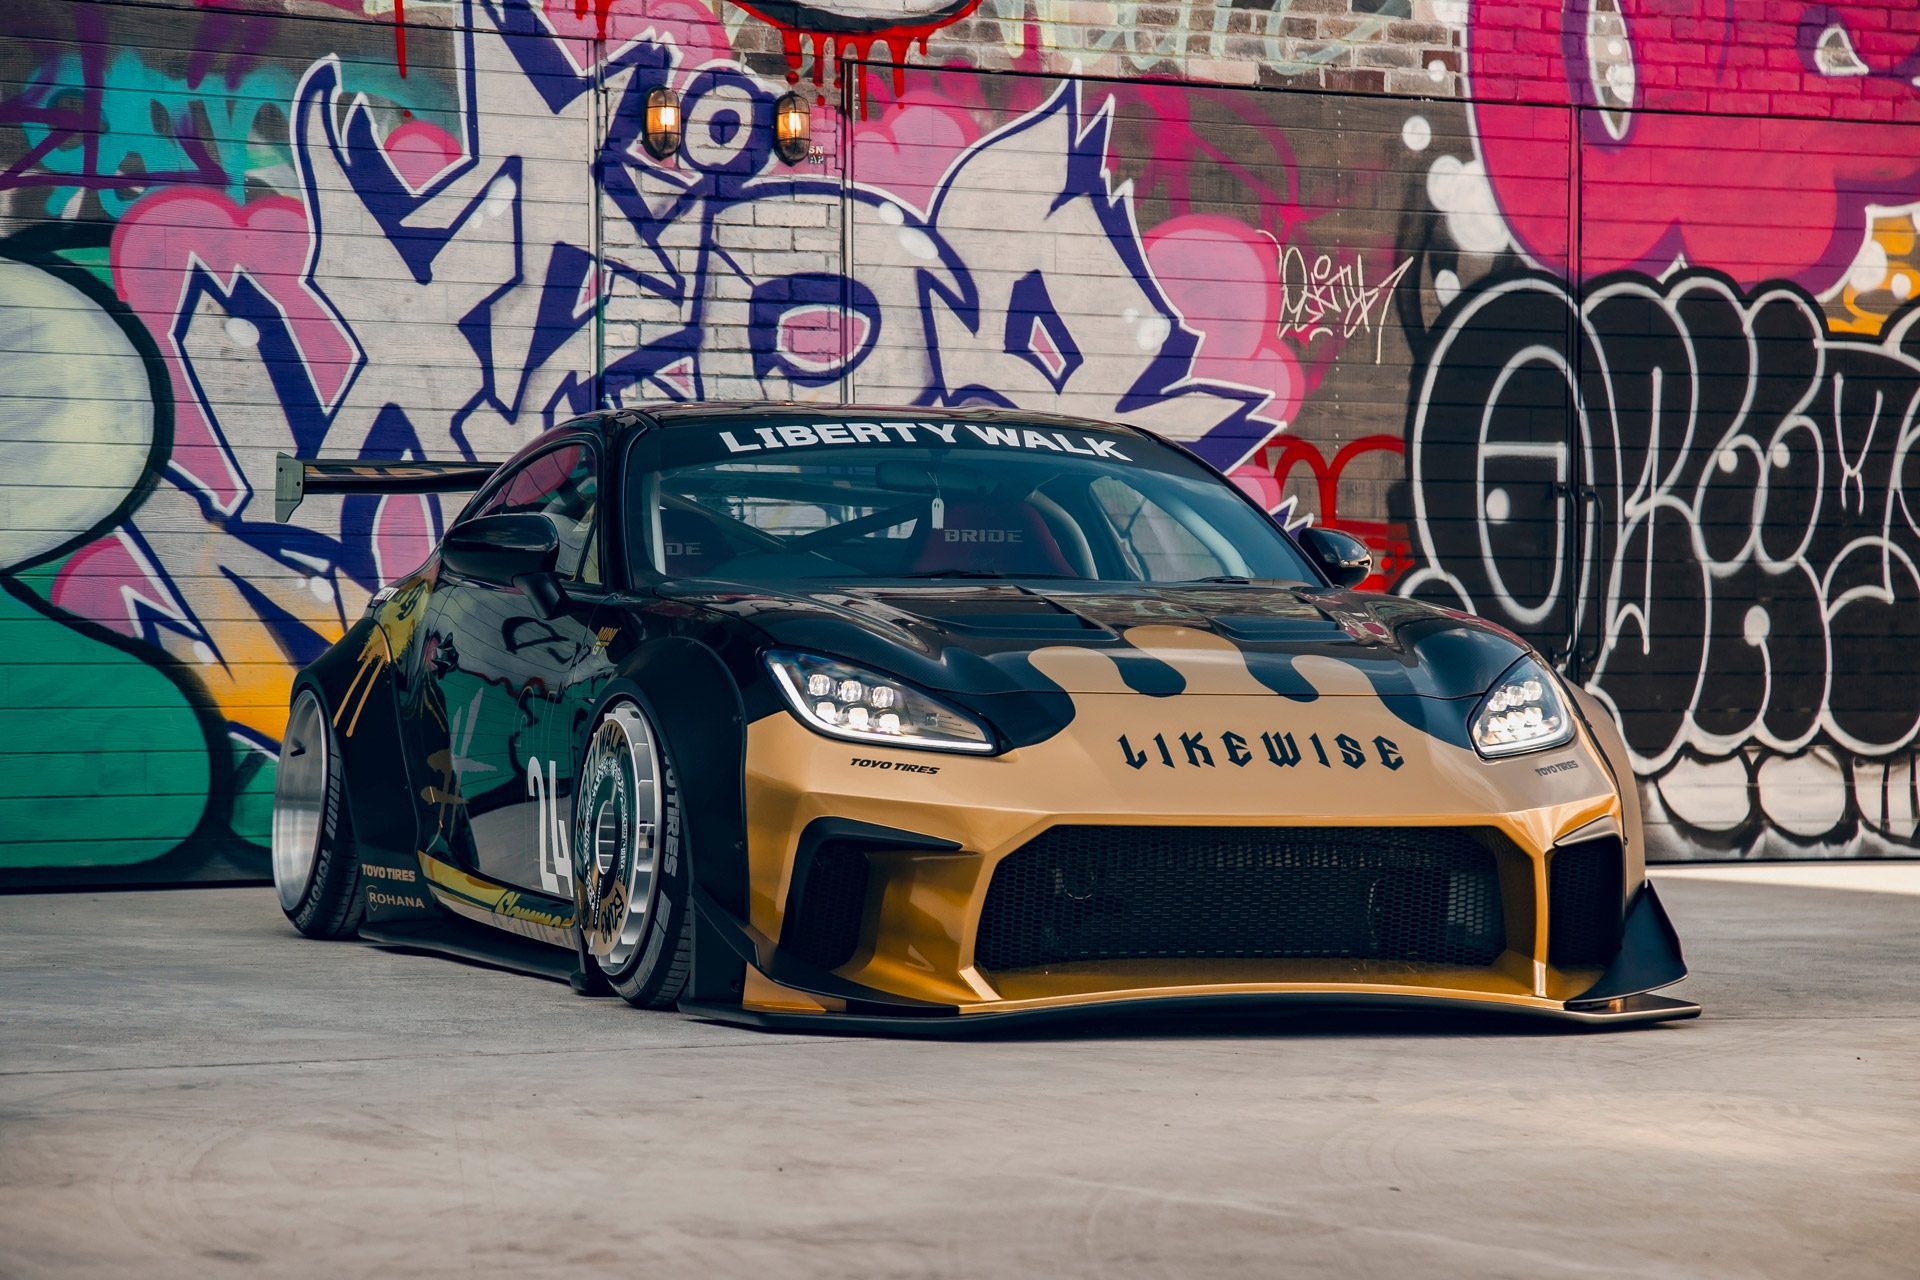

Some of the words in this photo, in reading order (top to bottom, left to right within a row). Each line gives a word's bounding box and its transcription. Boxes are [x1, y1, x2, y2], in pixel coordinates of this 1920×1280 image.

[718, 422, 958, 453] LIBERTY
[964, 424, 1133, 462] WALK
[944, 529, 1024, 543] BRIDE
[1117, 730, 1405, 771] LIKEWISE
[850, 758, 893, 769] TOYO
[894, 762, 940, 775] TIRES
[1535, 765, 1557, 776] TOYO
[1555, 760, 1579, 771] TIRES
[527, 755, 574, 898] 24
[663, 790, 680, 877] TIRES
[361, 863, 386, 879] TOYO
[386, 867, 416, 883] TIRES
[368, 892, 425, 909] ROHANA
